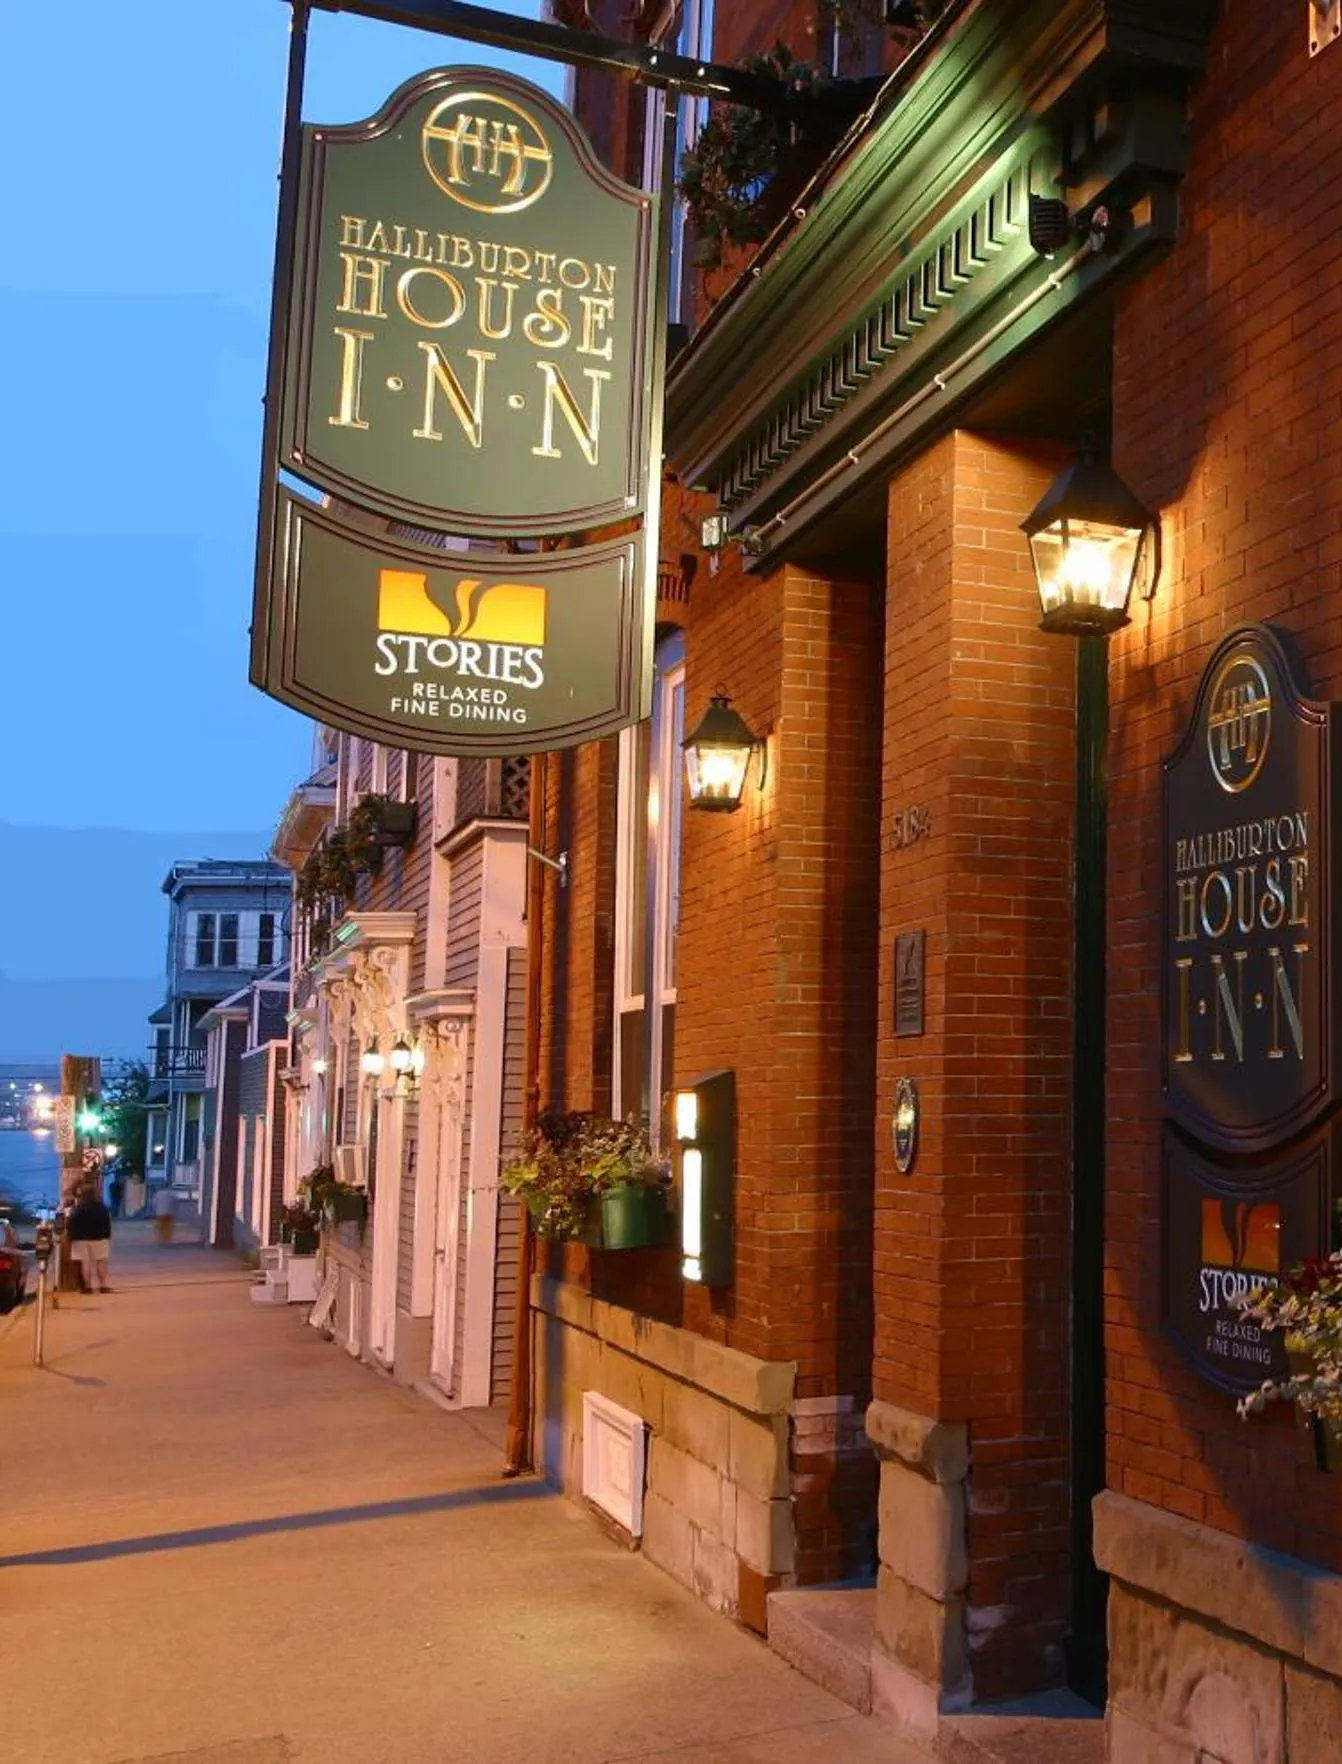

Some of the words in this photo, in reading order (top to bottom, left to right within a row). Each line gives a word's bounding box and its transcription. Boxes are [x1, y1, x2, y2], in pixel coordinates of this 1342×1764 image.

[339, 215, 617, 294] HALLIBURTON
[335, 251, 615, 361] HOUSE
[374, 634, 545, 690] STORIES
[390, 698, 441, 717] FINE
[448, 703, 528, 724] DINING
[412, 682, 508, 705] RELAXED
[1175, 812, 1310, 871] HALLIBURTON
[1175, 854, 1310, 942] HOUSE
[1206, 1336, 1230, 1356] FINE
[1232, 1343, 1272, 1365] DINING
[1216, 1319, 1261, 1343] RELAXED
